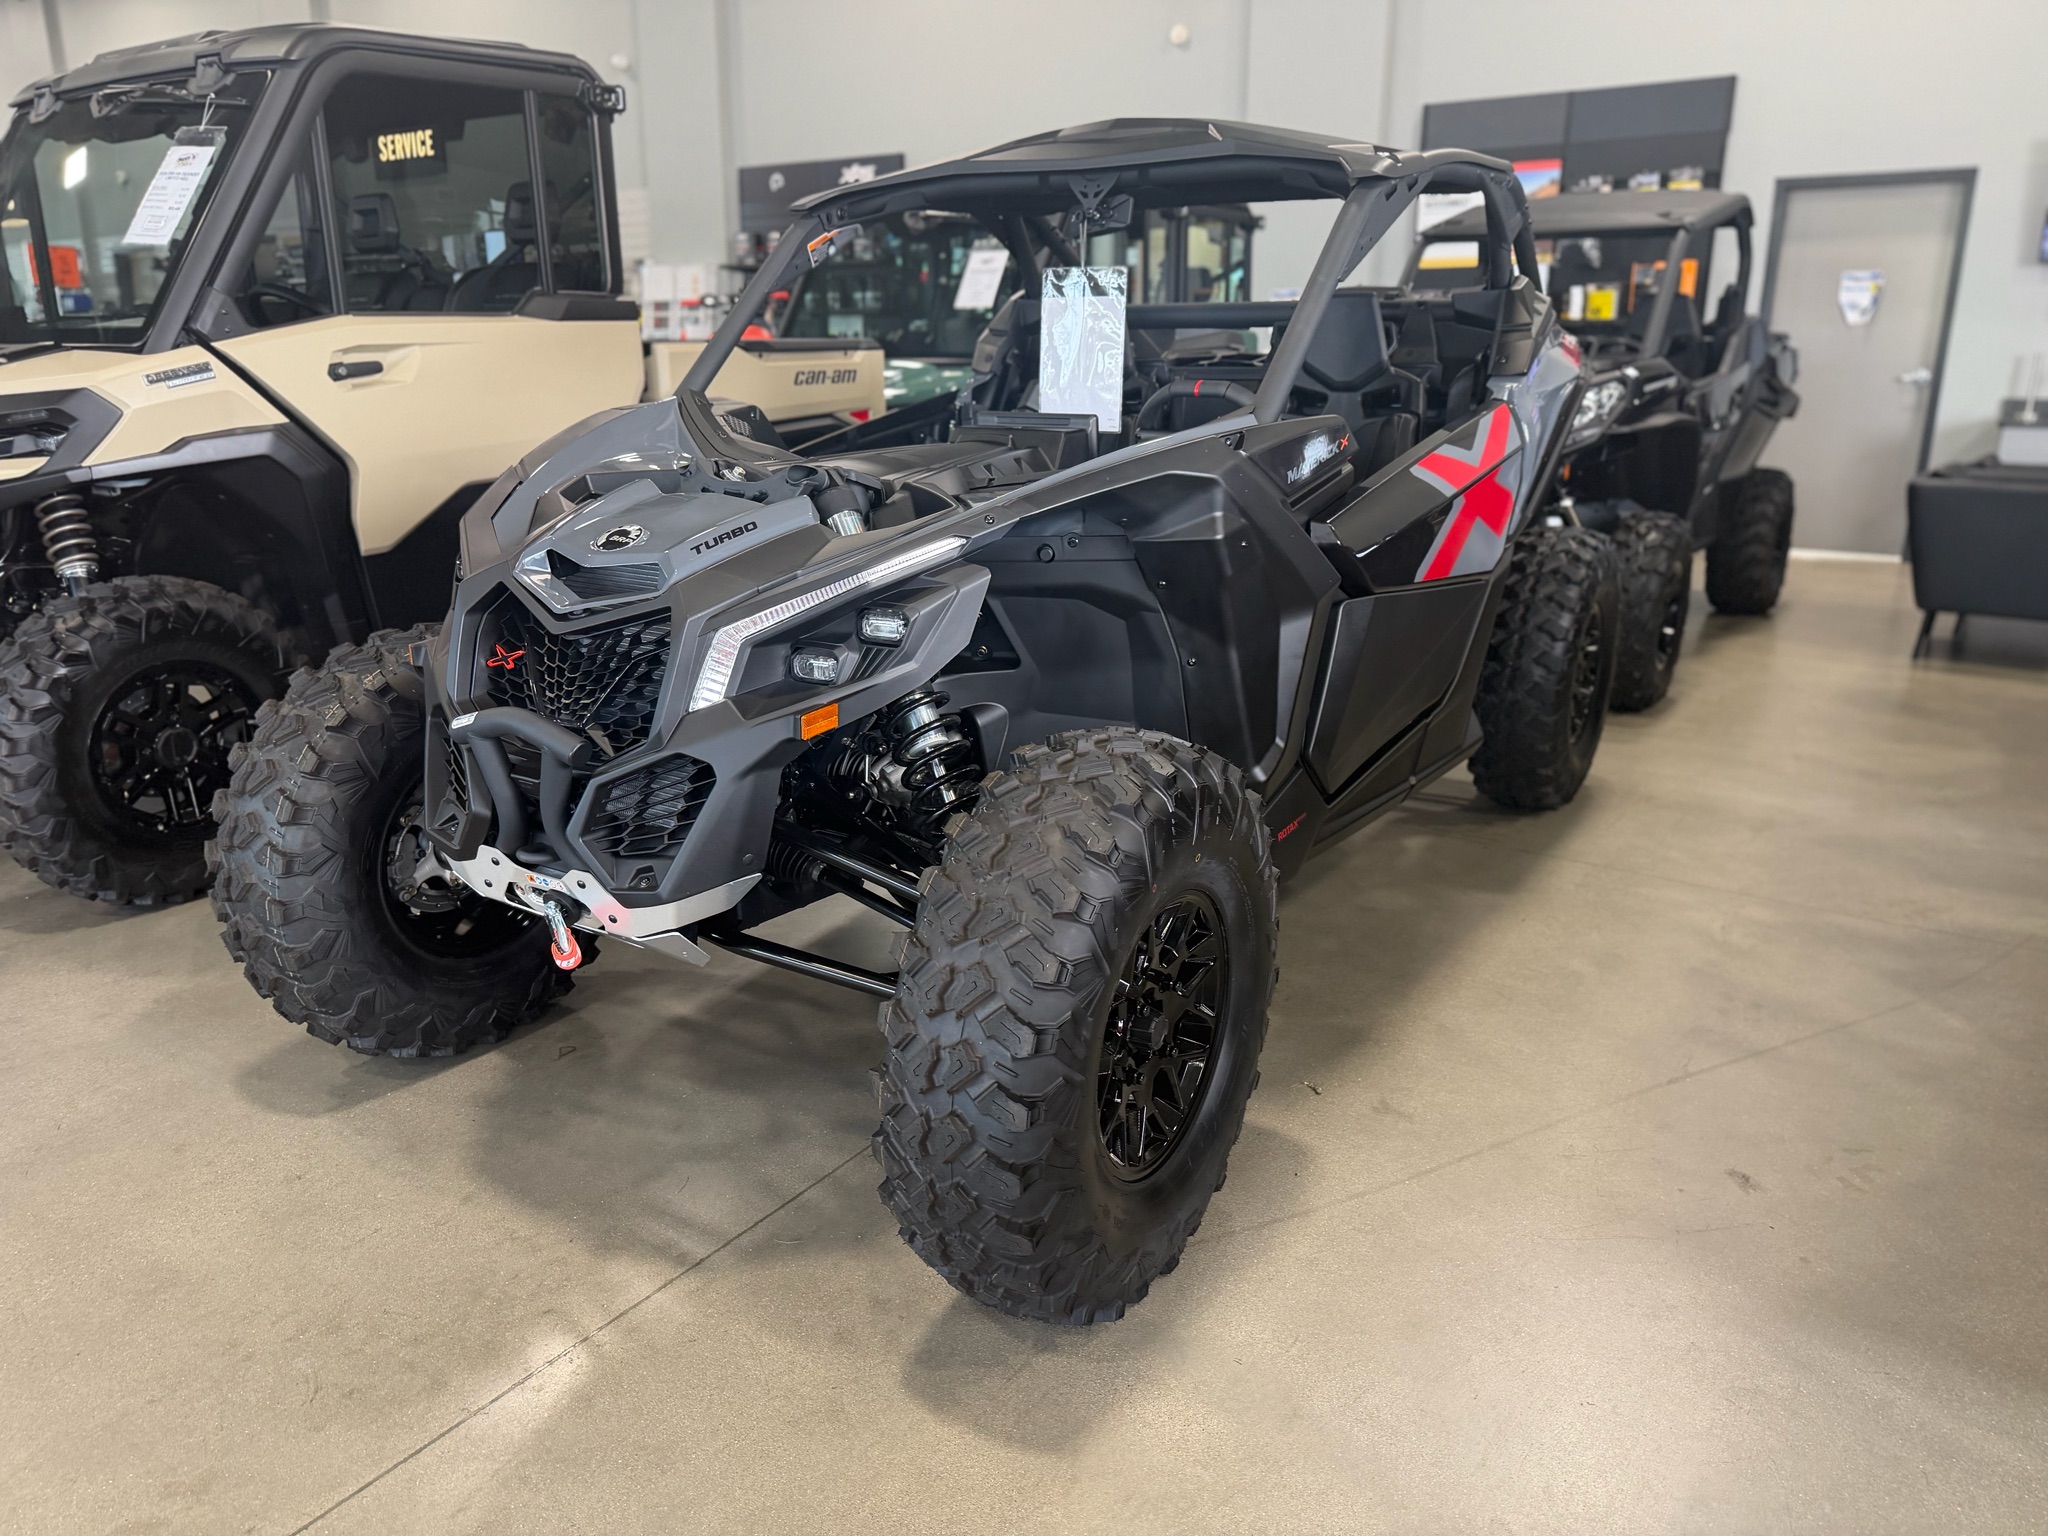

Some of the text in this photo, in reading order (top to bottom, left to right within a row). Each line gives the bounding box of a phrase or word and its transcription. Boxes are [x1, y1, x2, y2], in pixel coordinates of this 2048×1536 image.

[377, 128, 435, 162] SERVICE
[794, 369, 857, 386] can-am
[690, 521, 758, 555] TURBO
